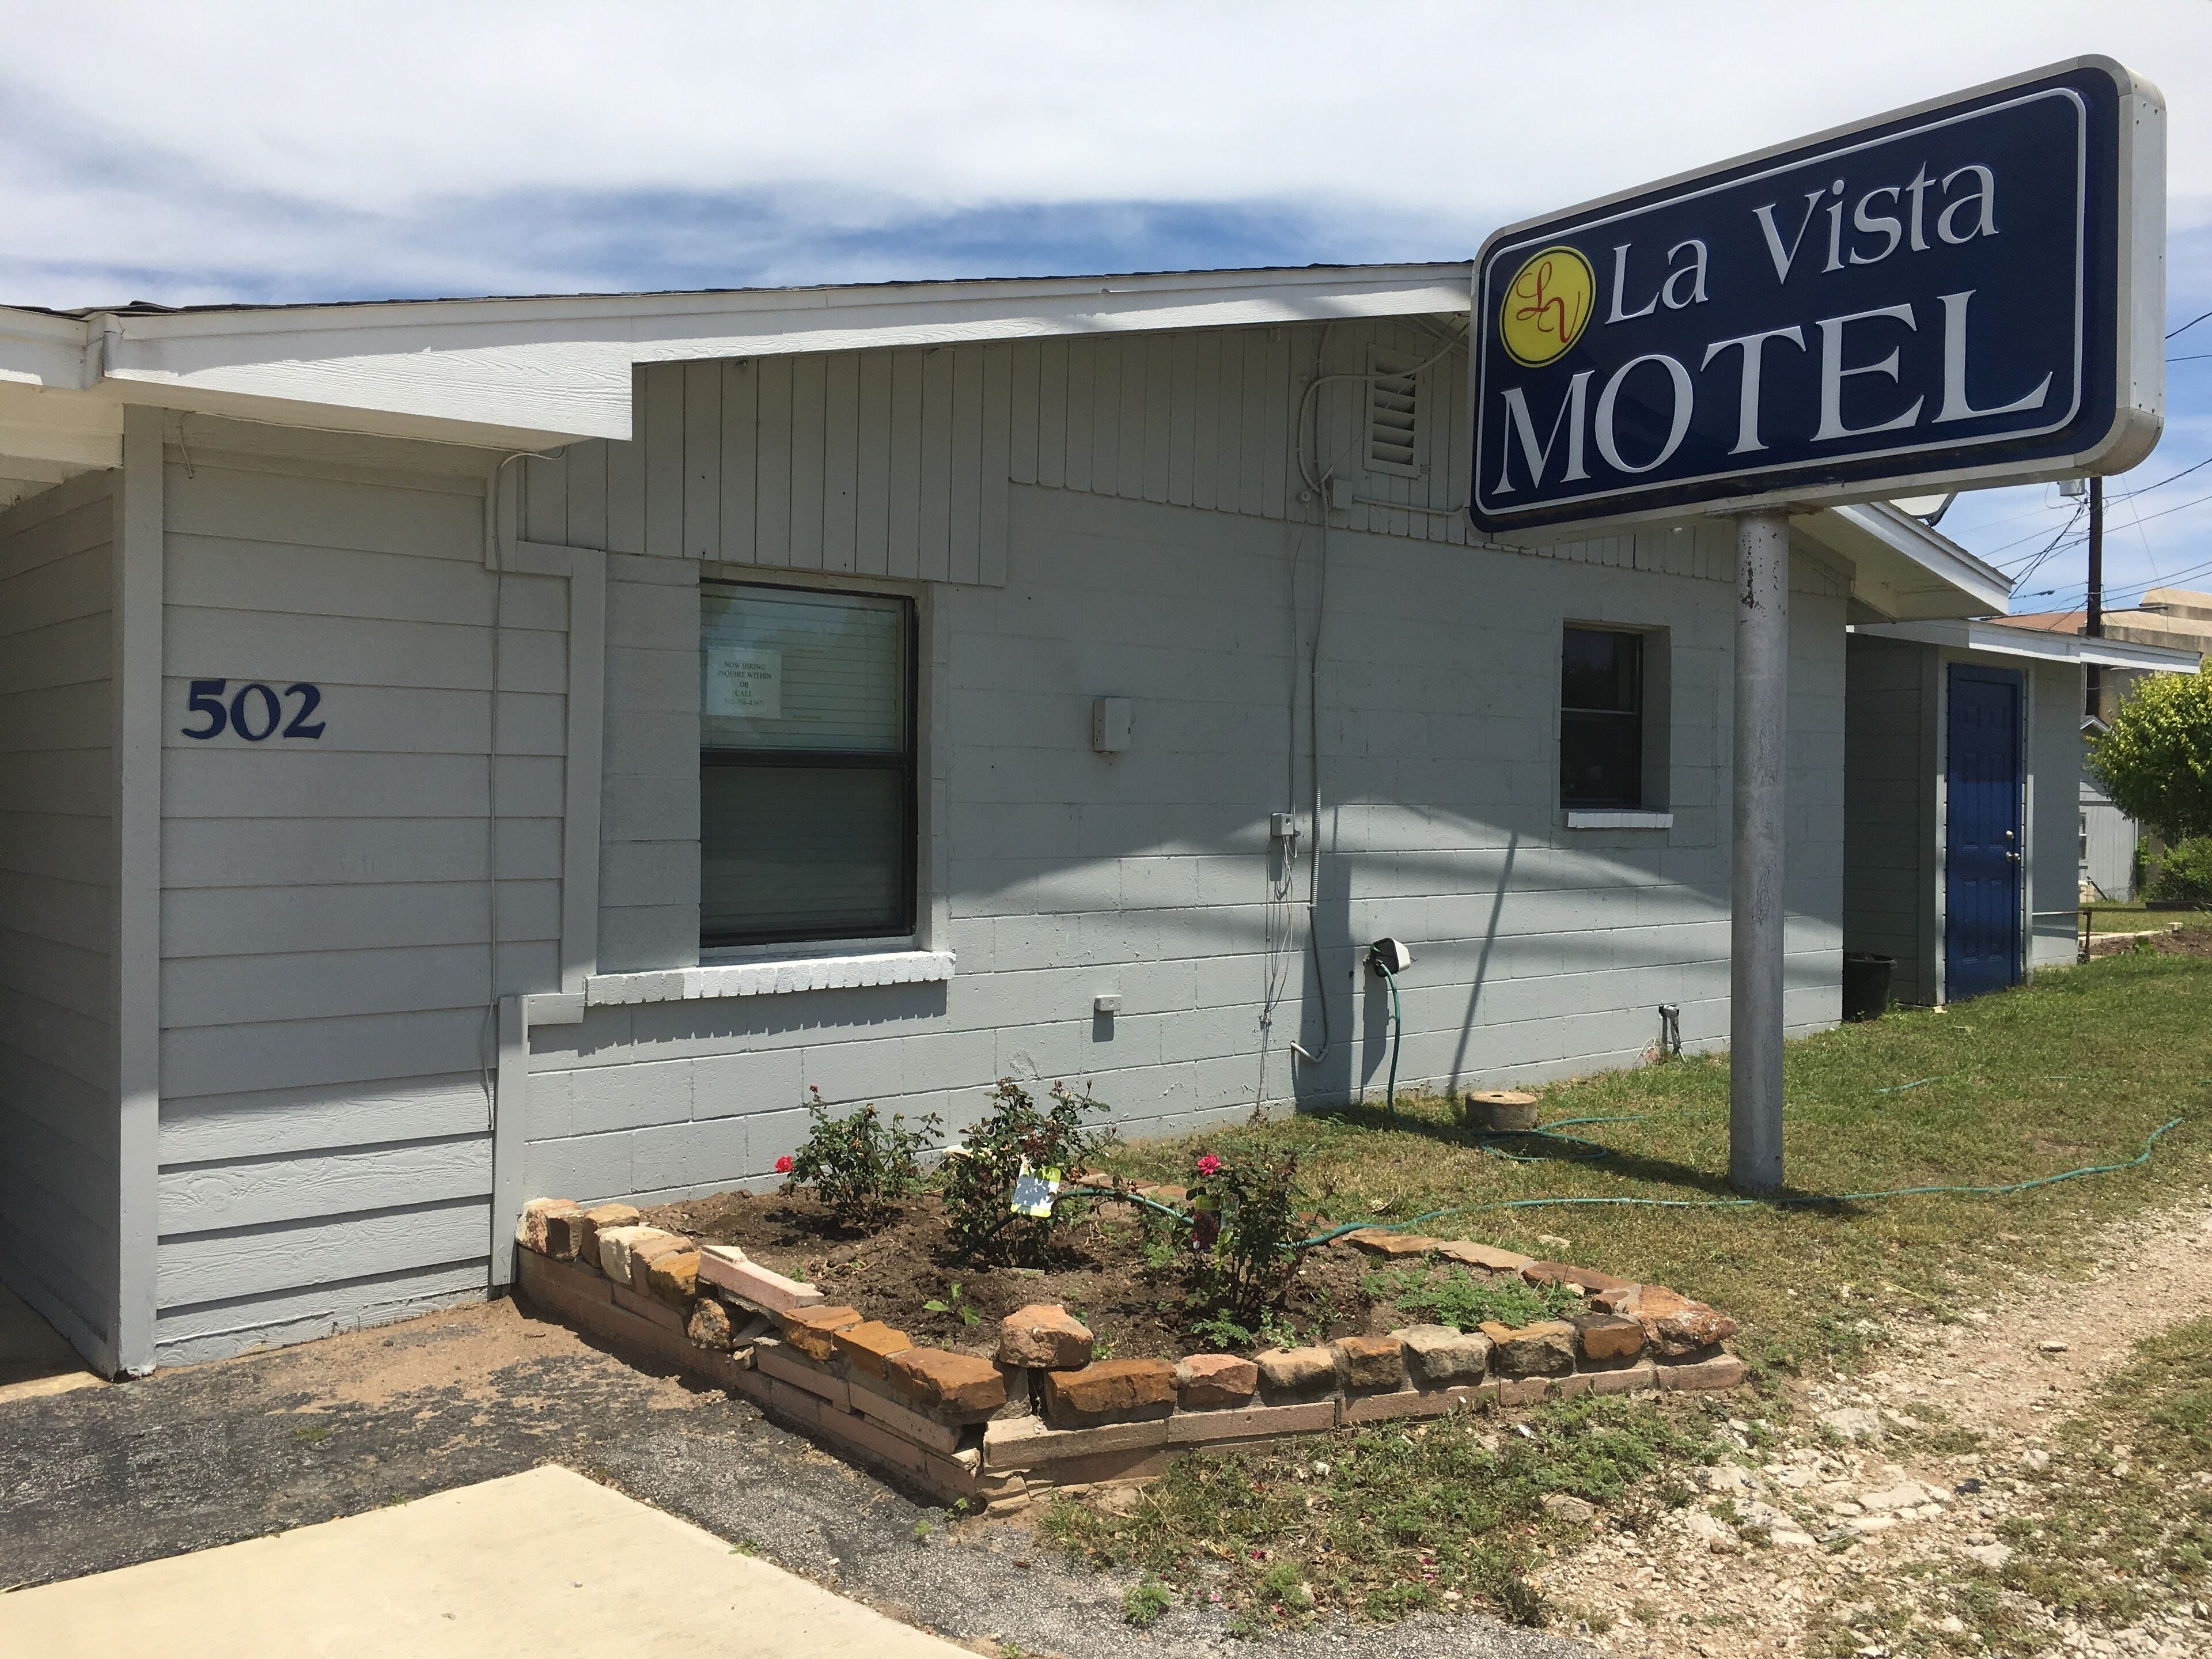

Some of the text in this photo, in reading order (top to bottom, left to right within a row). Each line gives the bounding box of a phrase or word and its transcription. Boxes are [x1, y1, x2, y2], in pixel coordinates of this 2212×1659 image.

[1605, 162, 1999, 325] La Vista
[1492, 289, 2054, 496] MOTEL
[182, 678, 326, 741] 502
[718, 670, 745, 678] INQUIRE
